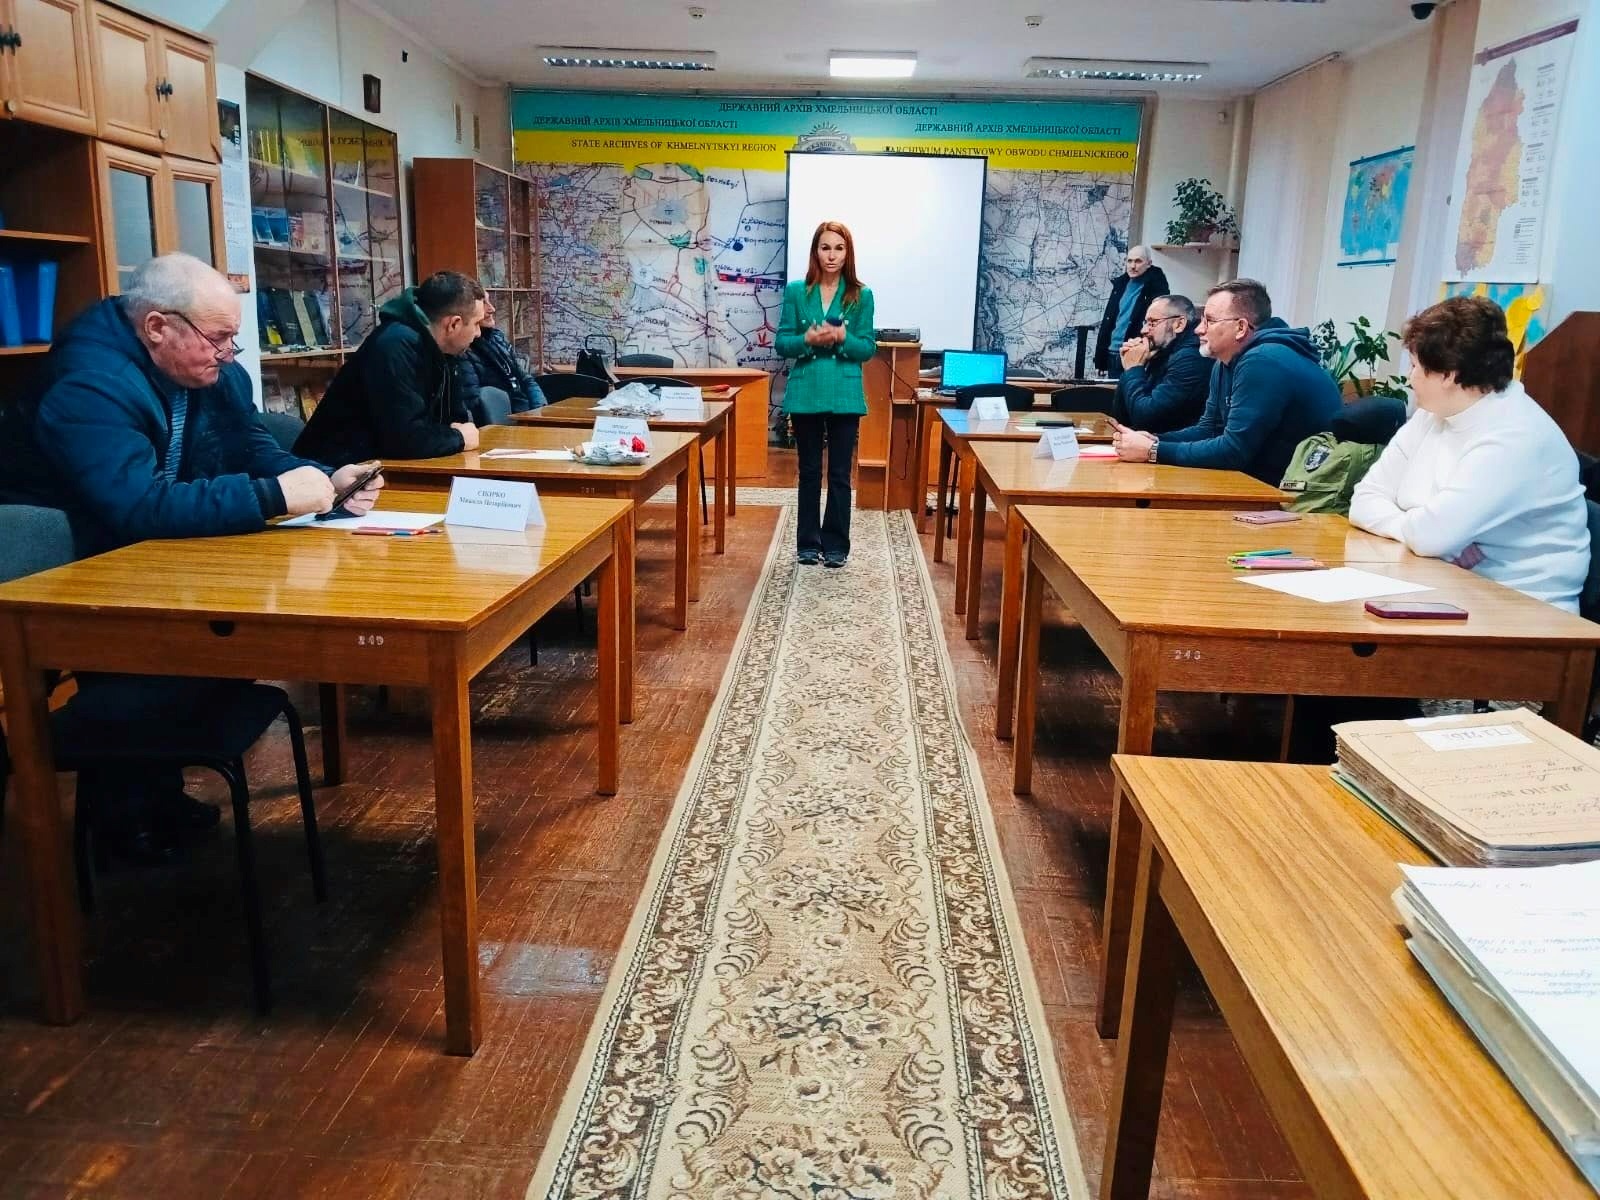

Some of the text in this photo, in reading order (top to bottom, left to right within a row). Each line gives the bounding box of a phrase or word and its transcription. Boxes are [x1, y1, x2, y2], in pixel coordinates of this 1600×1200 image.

[718, 102, 937, 116] ДЕРЖАВНИЙ АРХІВ ХМЕЛЬНИЦЬКОЇ ОБЛАСТІ
[533, 115, 738, 129] ДЕРЖАВНИЙ АРХІВ ХМЕЛЬНИЦЬКОЇ ОБЛАСТІ
[915, 122, 1121, 136] ДЕРЖАВНИЙ АРХІВ ХМЕЛЬНИЦЬКОЇ ОБЛАСТІ
[571, 139, 777, 152] STATE ARCHIVES OF KHMELNYTSKYI REGION
[1005, 147, 1047, 157] OBWODU
[1048, 149, 1129, 159] CHMIELNICKIEGO
